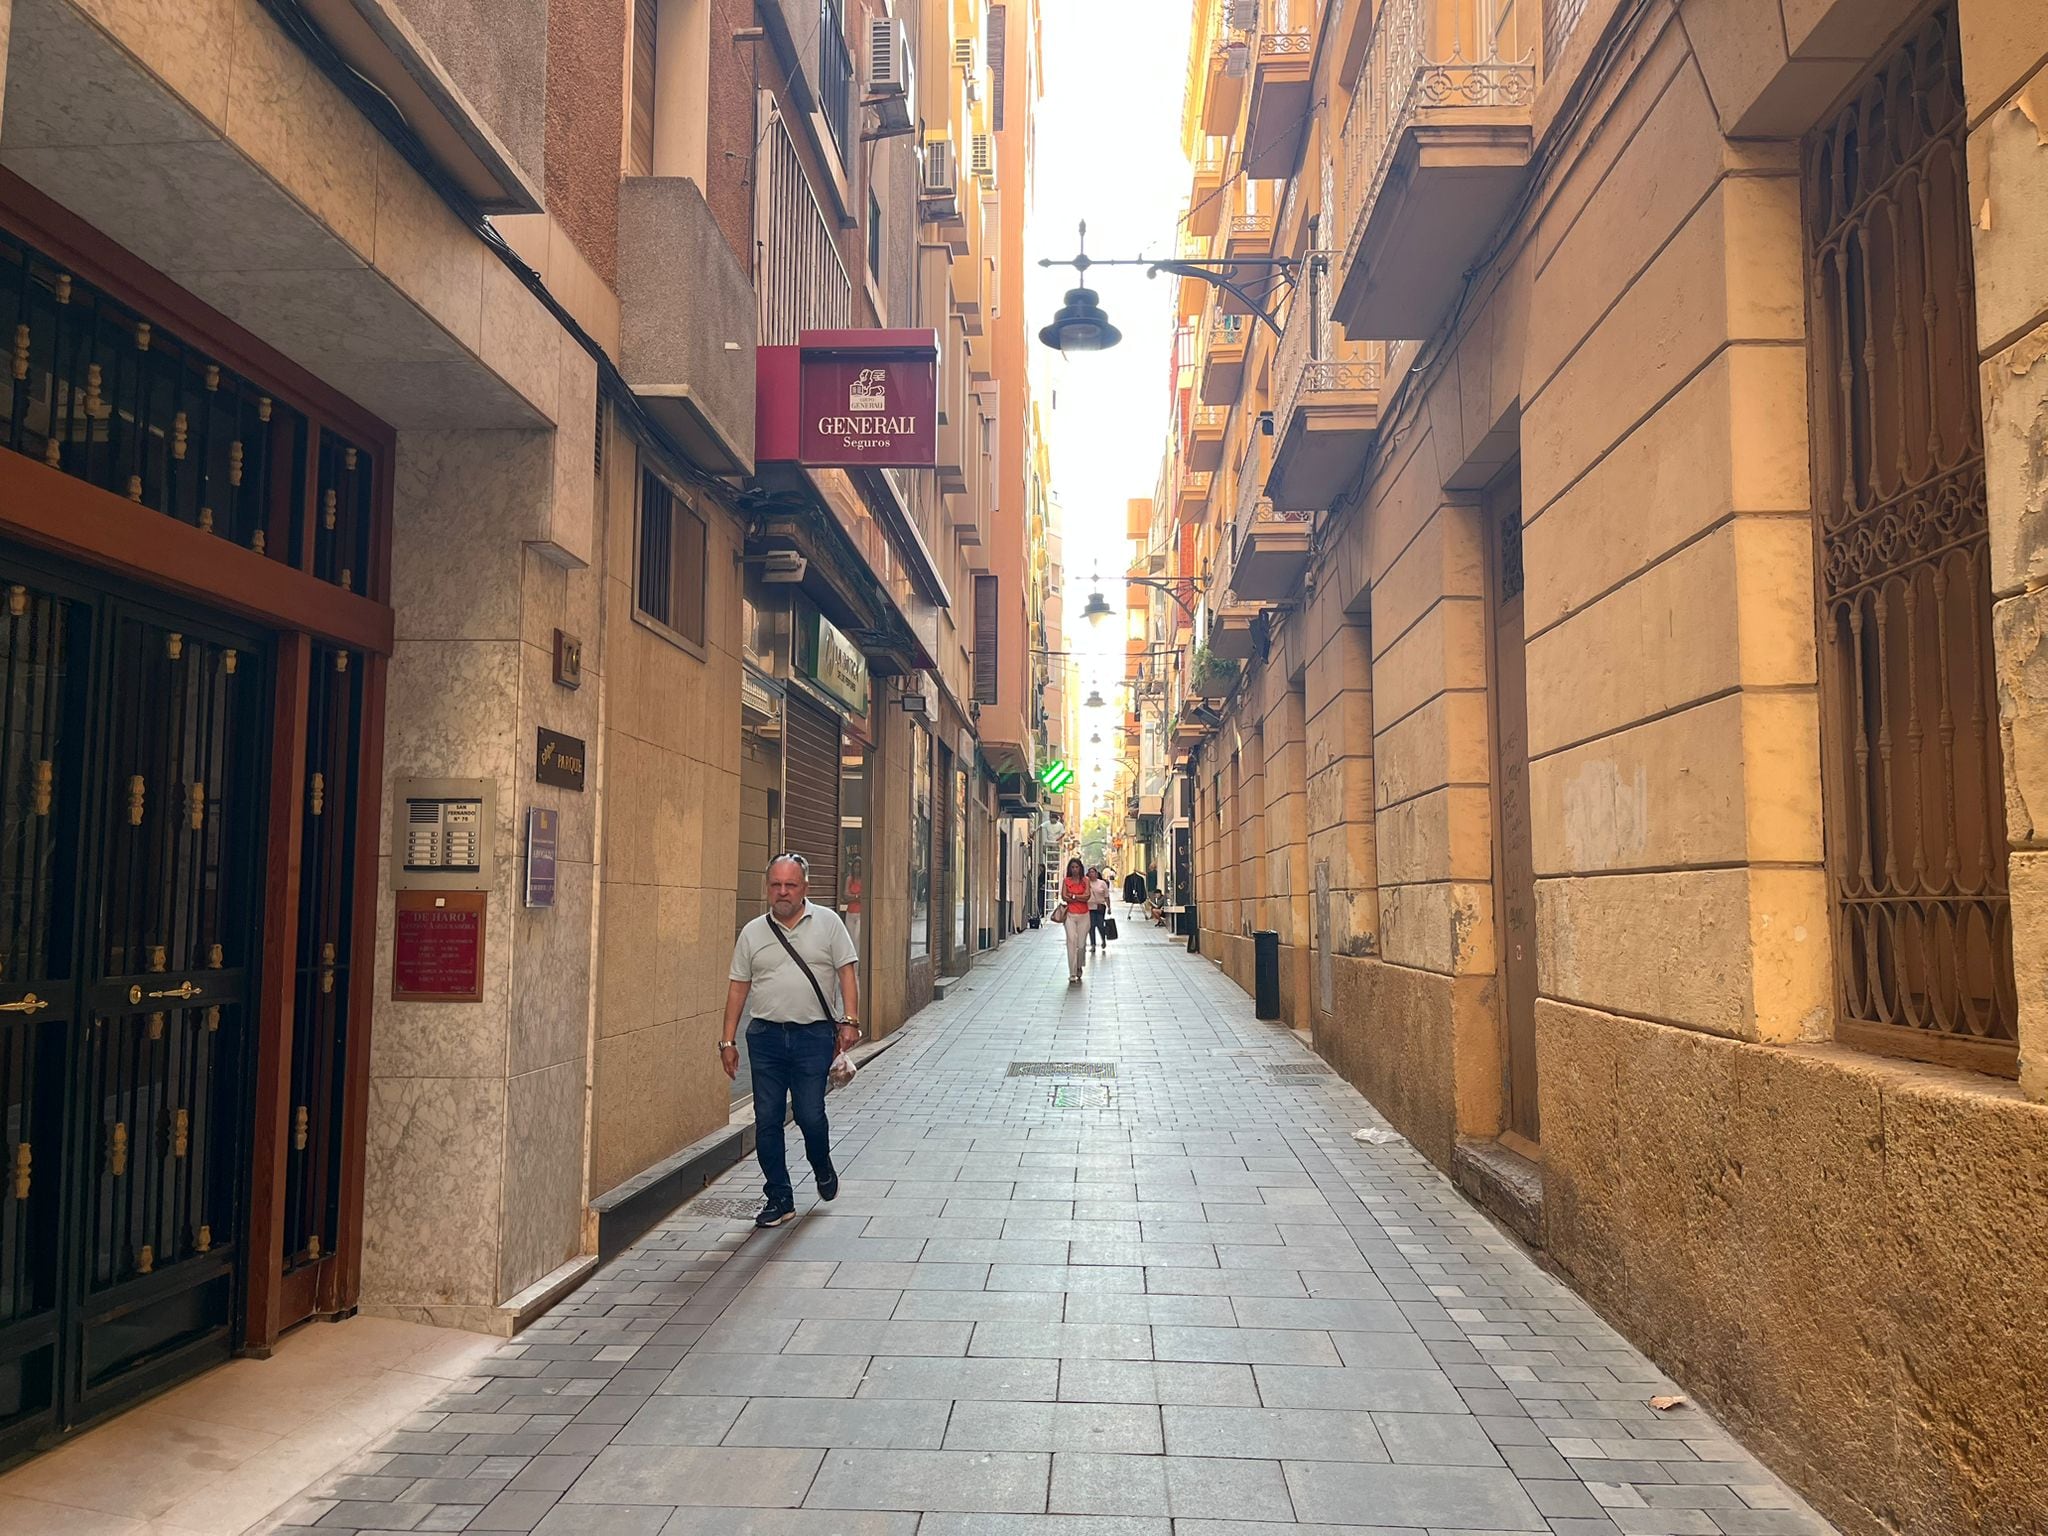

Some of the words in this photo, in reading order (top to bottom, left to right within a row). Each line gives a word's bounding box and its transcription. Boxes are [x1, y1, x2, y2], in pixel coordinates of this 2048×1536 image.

[818, 416, 916, 435] GENERALI
[843, 436, 891, 451] Seguros
[557, 754, 582, 775] PARQUE
[414, 912, 429, 922] DE
[432, 912, 466, 922] HARO
